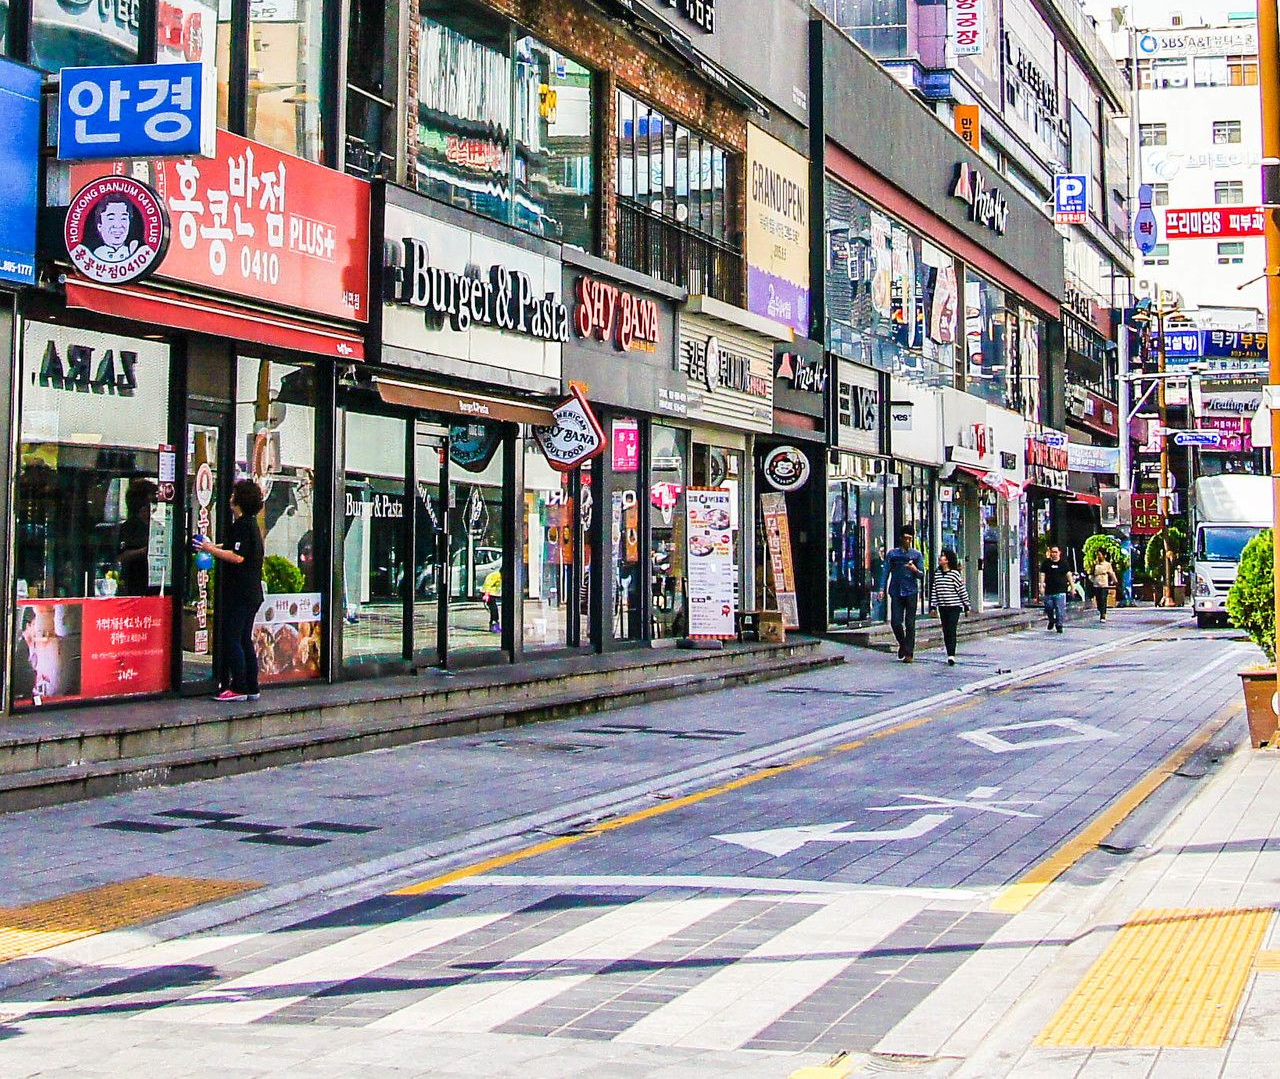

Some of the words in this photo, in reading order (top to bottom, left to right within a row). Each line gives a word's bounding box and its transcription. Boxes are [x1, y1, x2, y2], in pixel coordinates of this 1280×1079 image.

[1161, 36, 1184, 49] SBS
[1188, 35, 1212, 49] A&T
[68, 75, 193, 145] 안경
[1059, 178, 1083, 205] P
[69, 188, 99, 243] HONGKONG
[99, 182, 139, 197] BANJUM
[138, 193, 155, 215] 0410
[148, 215, 159, 244] PLUS
[170, 146, 287, 276] 홍콩반점
[1228, 212, 1264, 233] 피부과
[240, 245, 280, 285] 0410
[410, 238, 491, 332] Burger
[492, 264, 515, 330] &
[517, 270, 570, 344] Pasta
[580, 276, 618, 341] SHY
[620, 291, 661, 352] BANA
[556, 411, 587, 430] MERICAN
[563, 429, 595, 445] BANA
[563, 444, 584, 458] FOOD
